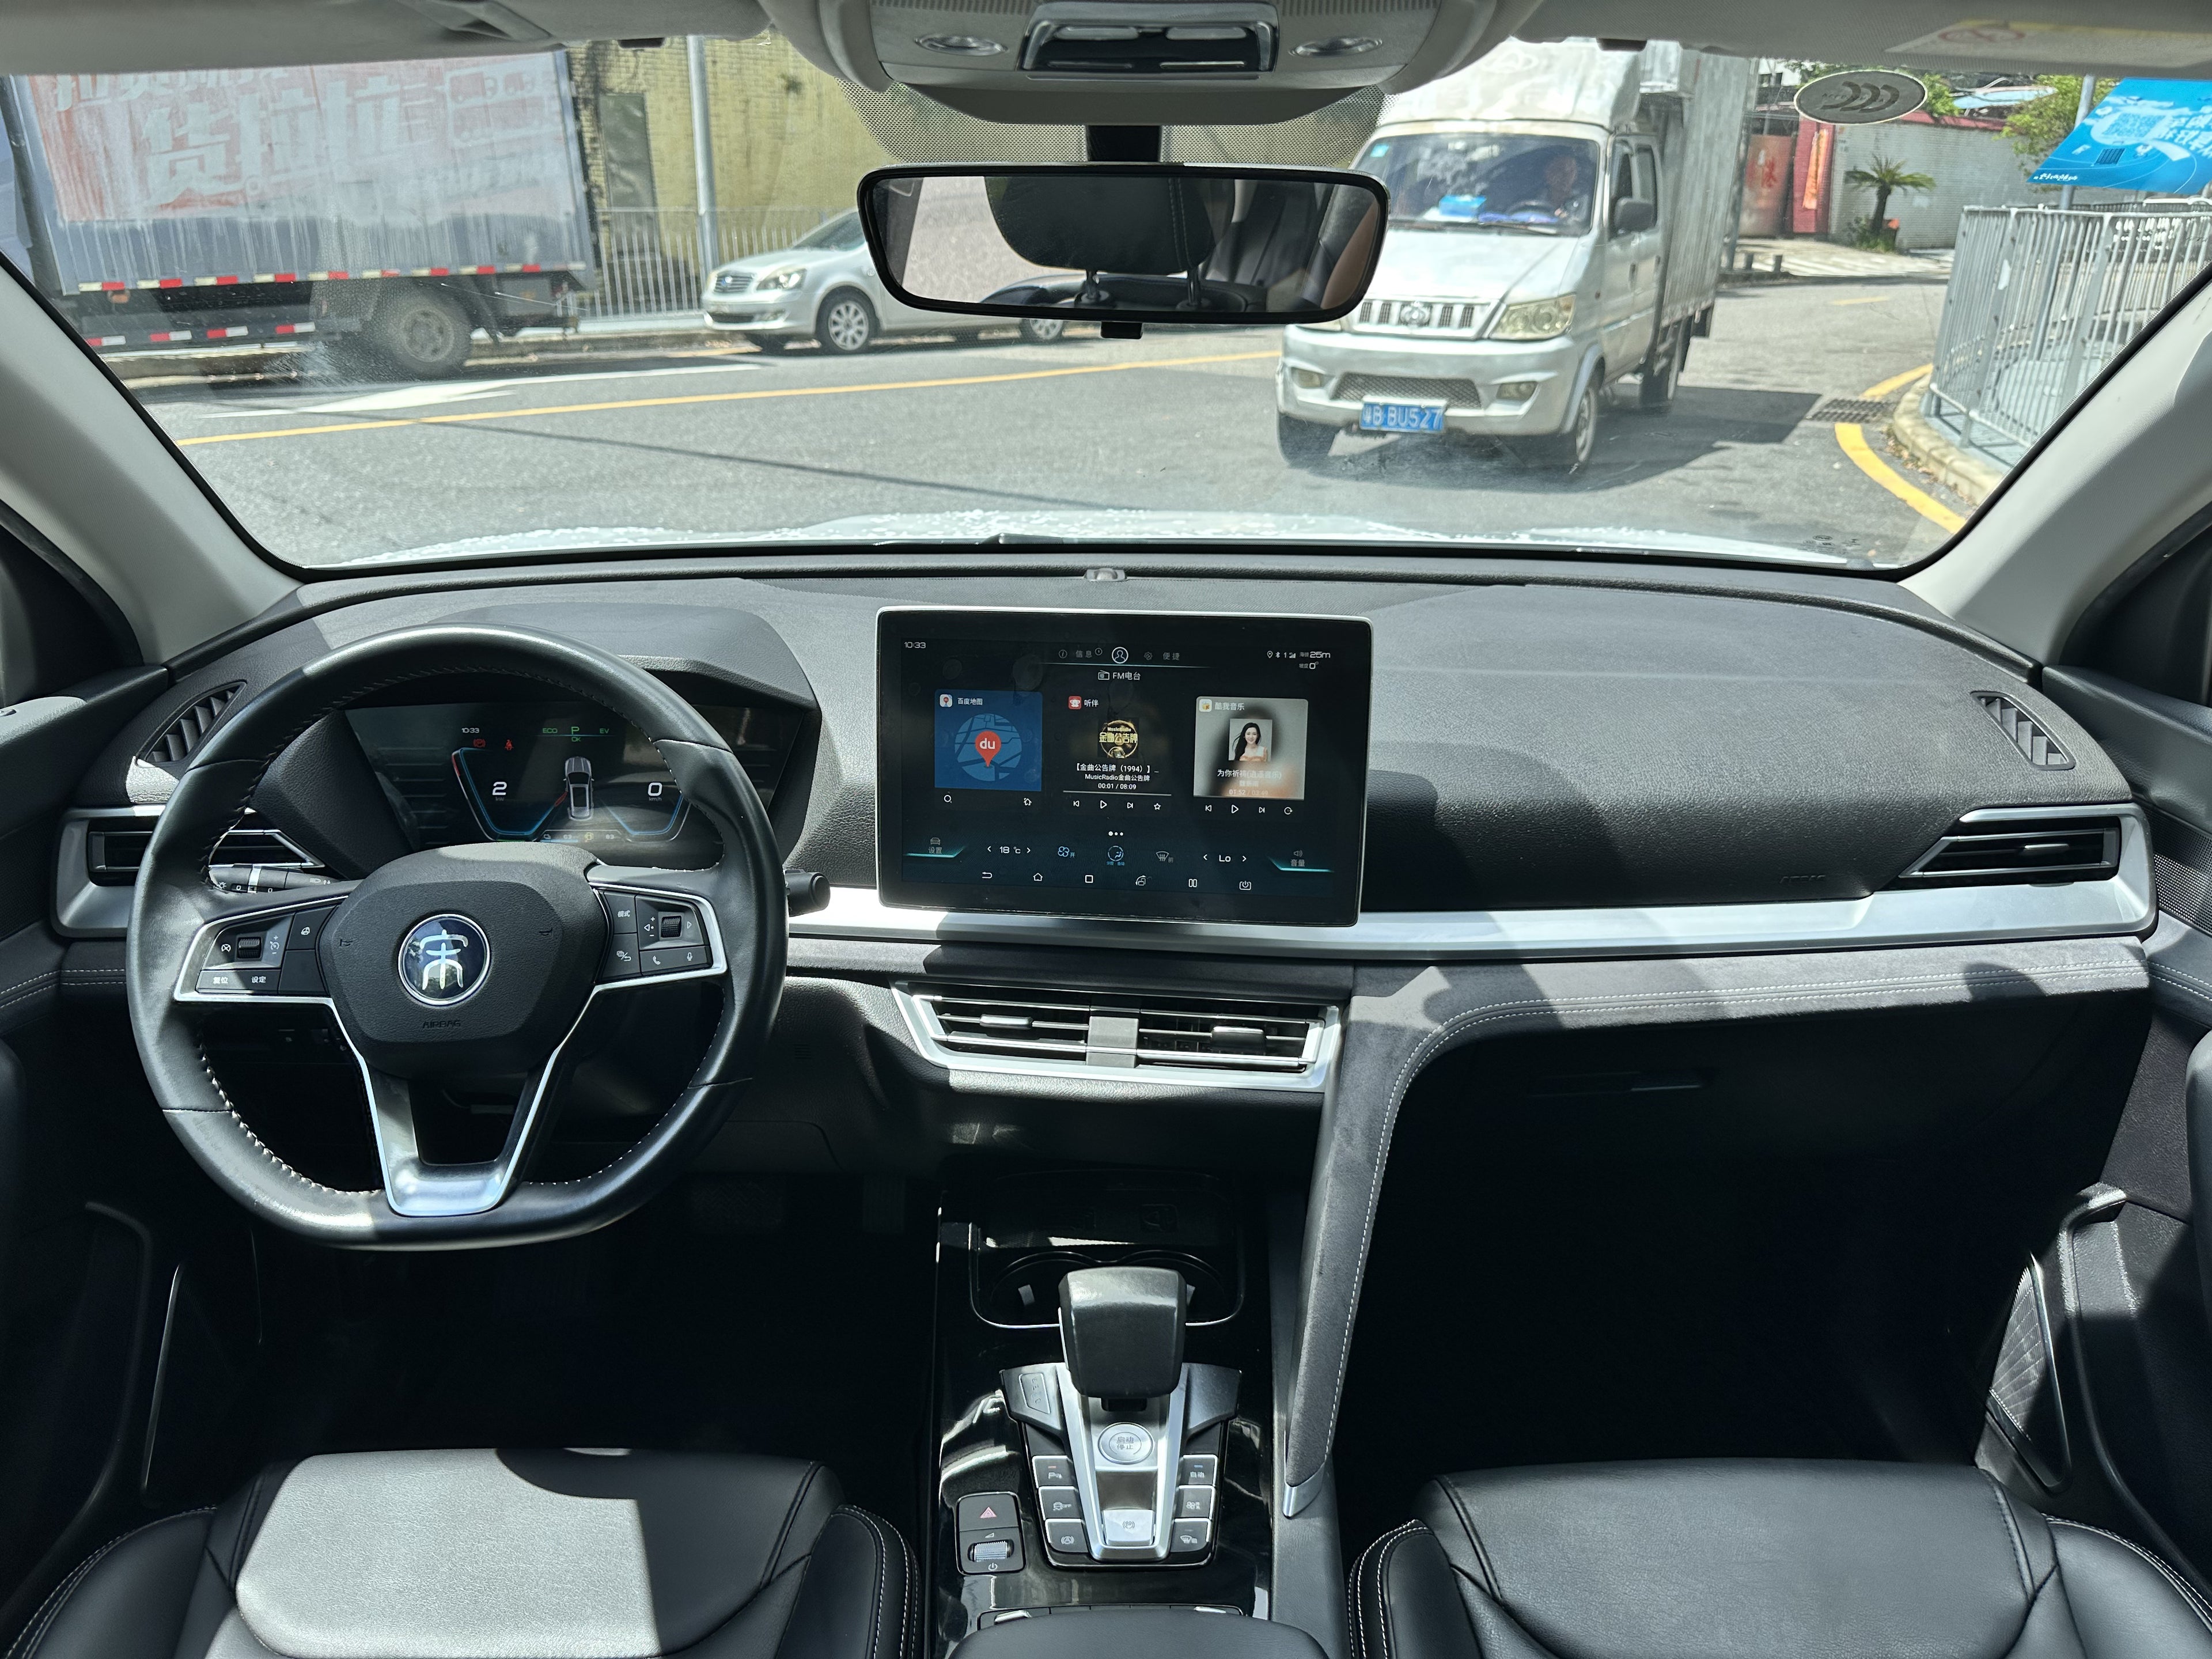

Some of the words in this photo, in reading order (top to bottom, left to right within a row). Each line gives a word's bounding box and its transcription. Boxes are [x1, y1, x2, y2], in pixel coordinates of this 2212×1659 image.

[1112, 671, 1141, 681] FM电台
[957, 698, 983, 706] 百度地图
[1084, 699, 1099, 707] 听伴
[1214, 702, 1245, 711] 酷我音乐
[571, 726, 579, 736] P
[1099, 732, 1138, 744] 金曲公告牌
[979, 738, 996, 750] du
[1085, 774, 1151, 782] MusicRadio金曲公告牌
[492, 781, 507, 796] 2
[647, 782, 663, 796] 0
[1219, 854, 1231, 863] Lo
[1290, 859, 1305, 868] 音量
[251, 976, 267, 984] 设定
[422, 1020, 461, 1029] AIRBAG
